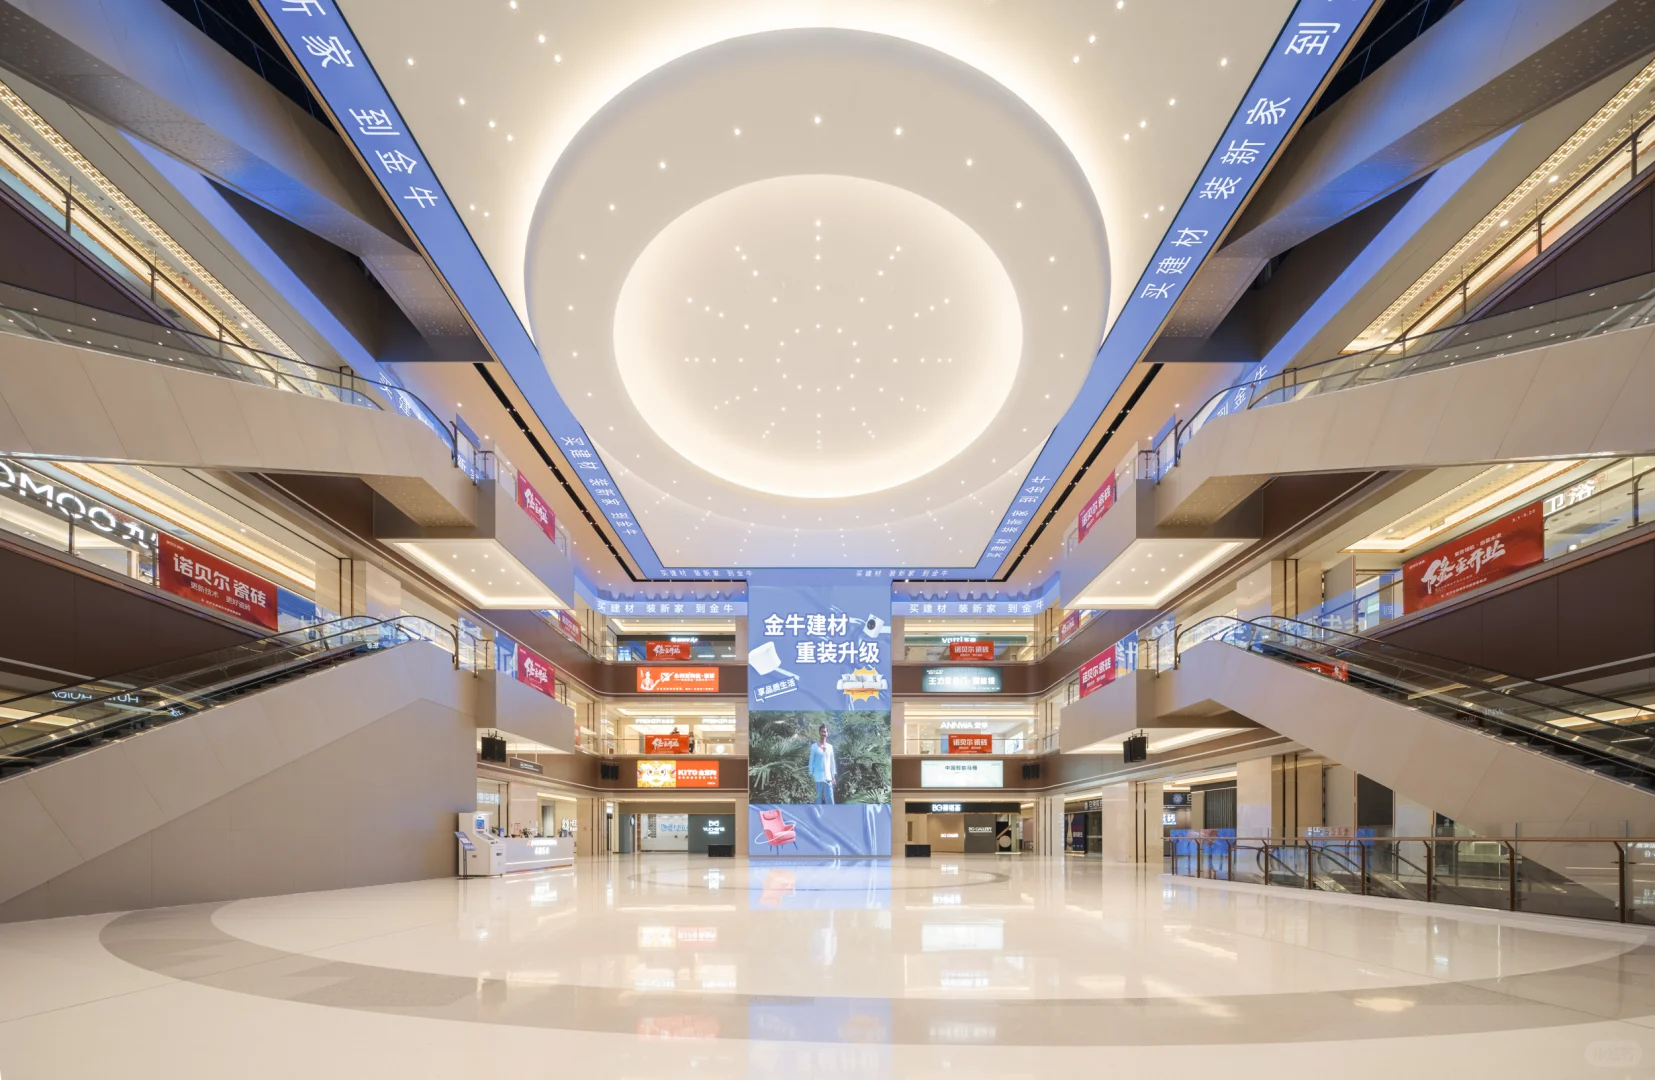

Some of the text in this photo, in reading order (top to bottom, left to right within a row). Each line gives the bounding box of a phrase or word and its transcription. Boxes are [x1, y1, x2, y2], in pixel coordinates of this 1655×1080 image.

[348, 108, 438, 208] 到金牛
[1140, 227, 1209, 299] 买建材
[1199, 97, 1291, 199] 装新家
[1546, 479, 1597, 513] 卫浴
[660, 569, 754, 577] 买建材 装新家 到金牛
[855, 569, 949, 577] 买建材 装新家 到金牛
[1420, 539, 1506, 595] 隆重开业
[597, 601, 734, 613] 买建材 装新家 到金牛
[909, 600, 1044, 613] 买建材 装新家 到金牛
[763, 613, 848, 636] 金牛建材
[795, 641, 880, 664] 重装升级
[757, 679, 796, 696] 享品质生活
[940, 721, 973, 729] ANNWA
